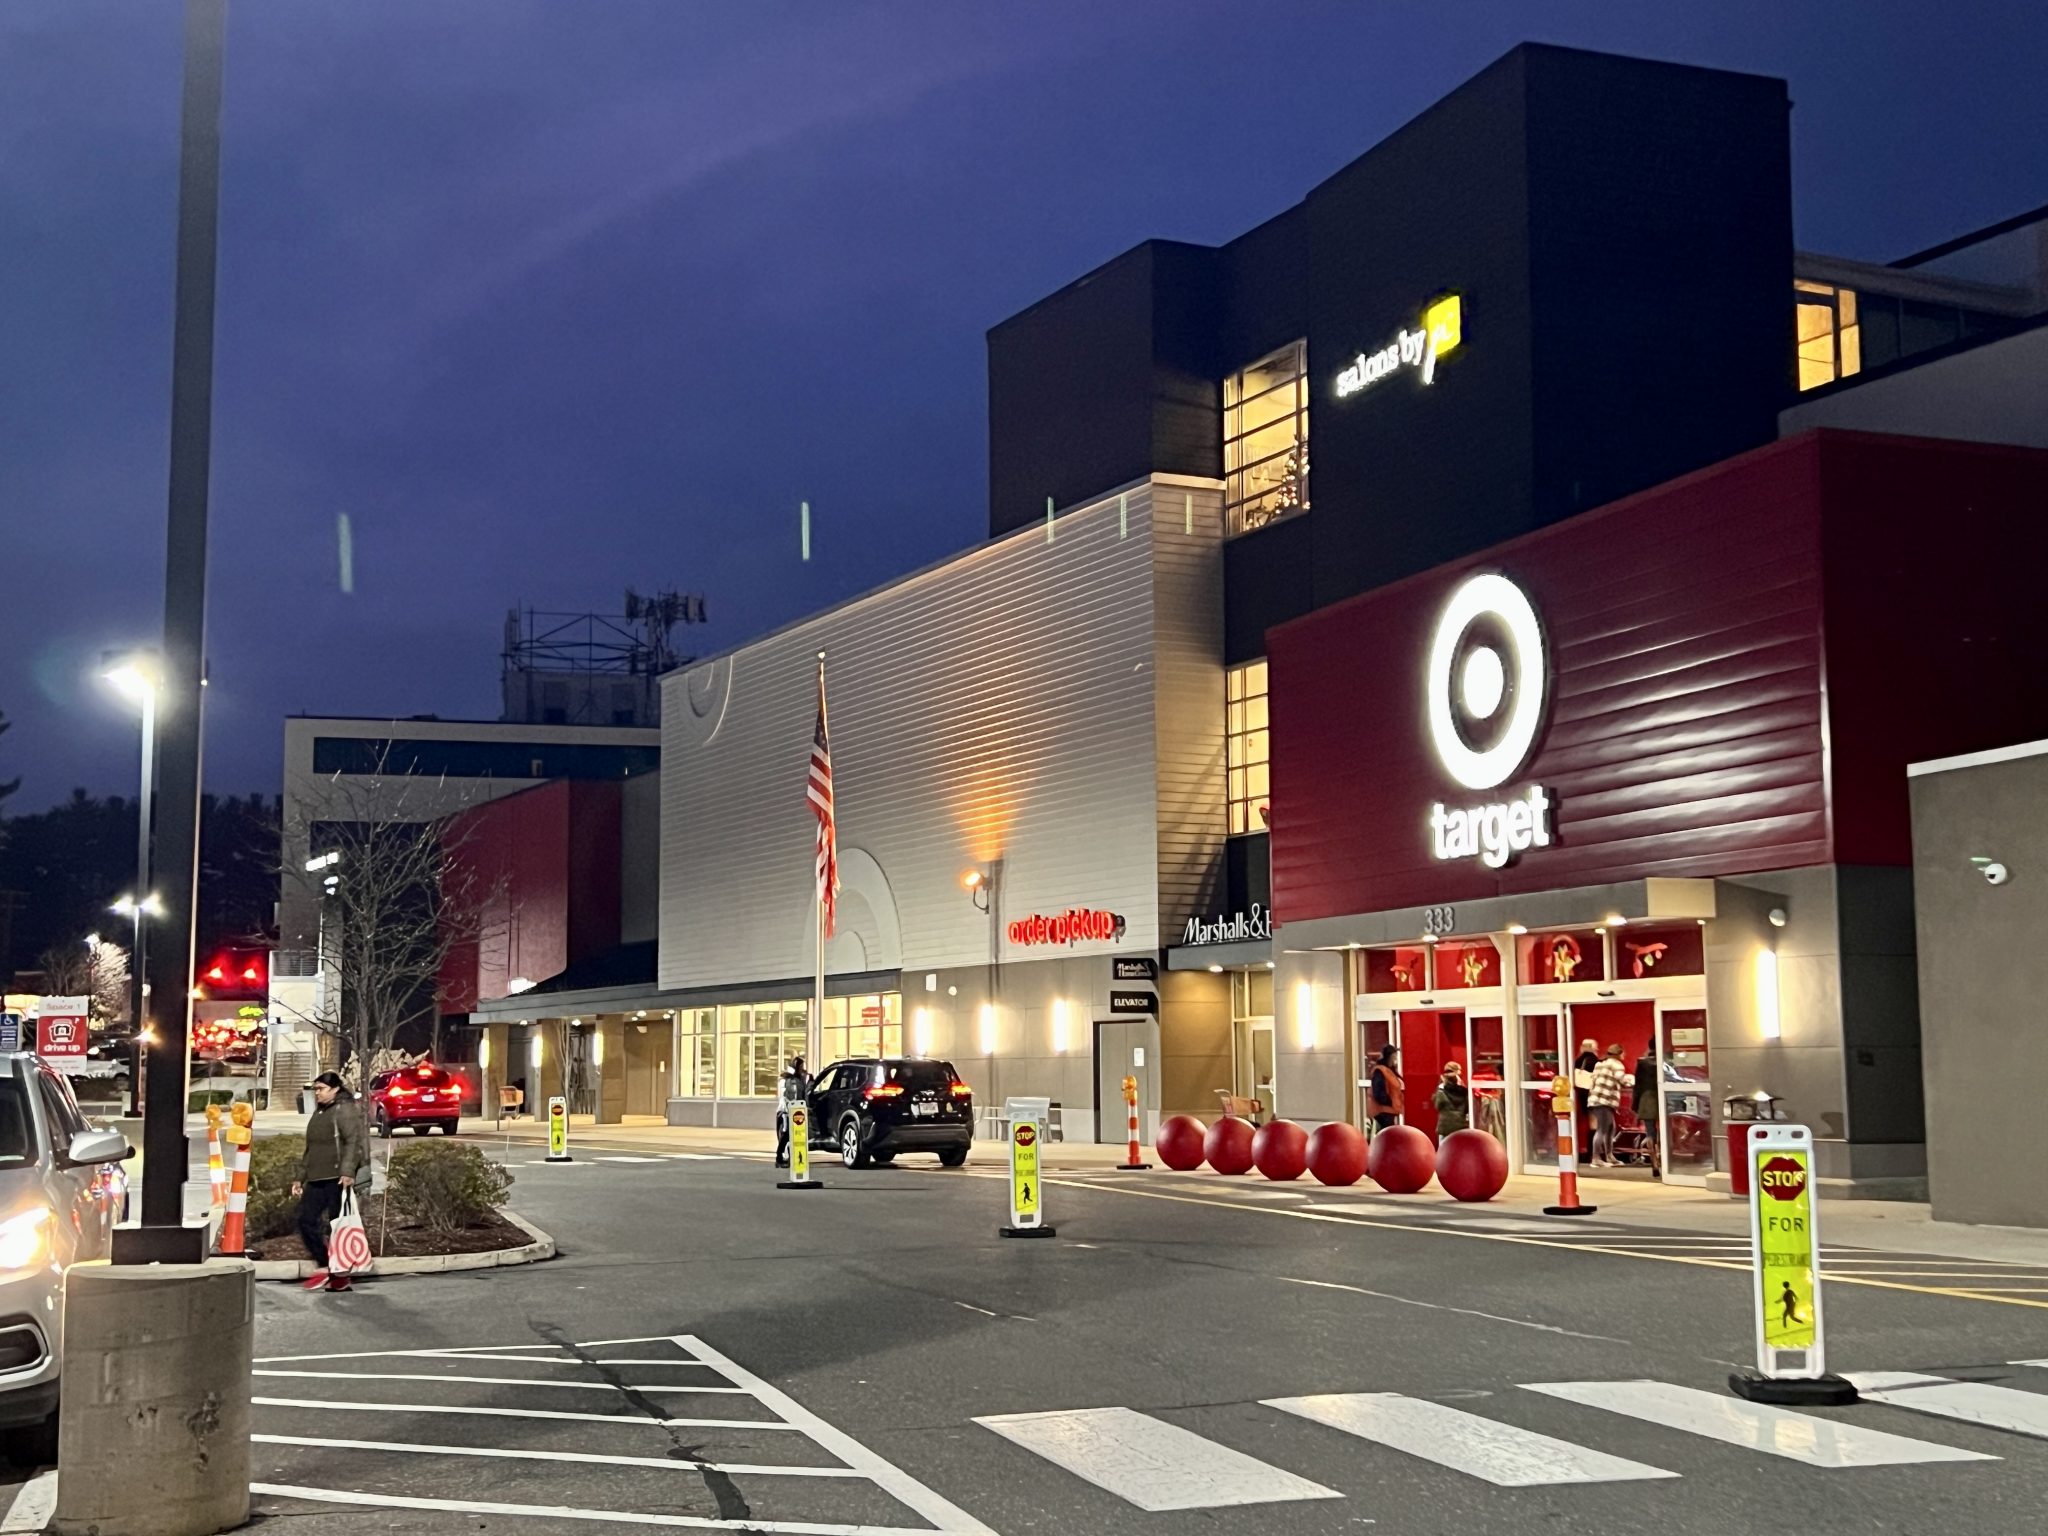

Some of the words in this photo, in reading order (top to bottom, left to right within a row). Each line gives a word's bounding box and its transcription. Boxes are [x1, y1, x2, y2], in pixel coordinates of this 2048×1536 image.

[1336, 344, 1399, 397] salons
[1399, 329, 1426, 366] by
[1431, 785, 1550, 868] target
[1008, 913, 1052, 944] order
[1054, 908, 1114, 944] pickup
[1424, 907, 1455, 933] 333
[1114, 998, 1149, 1007] ELEVATOR
[44, 1043, 67, 1052] drive
[68, 1044, 80, 1053] up
[1016, 1131, 1035, 1140] STOP
[1018, 1153, 1034, 1161] FOR
[1763, 1171, 1806, 1187] STOP
[1769, 1217, 1804, 1232] FOR
